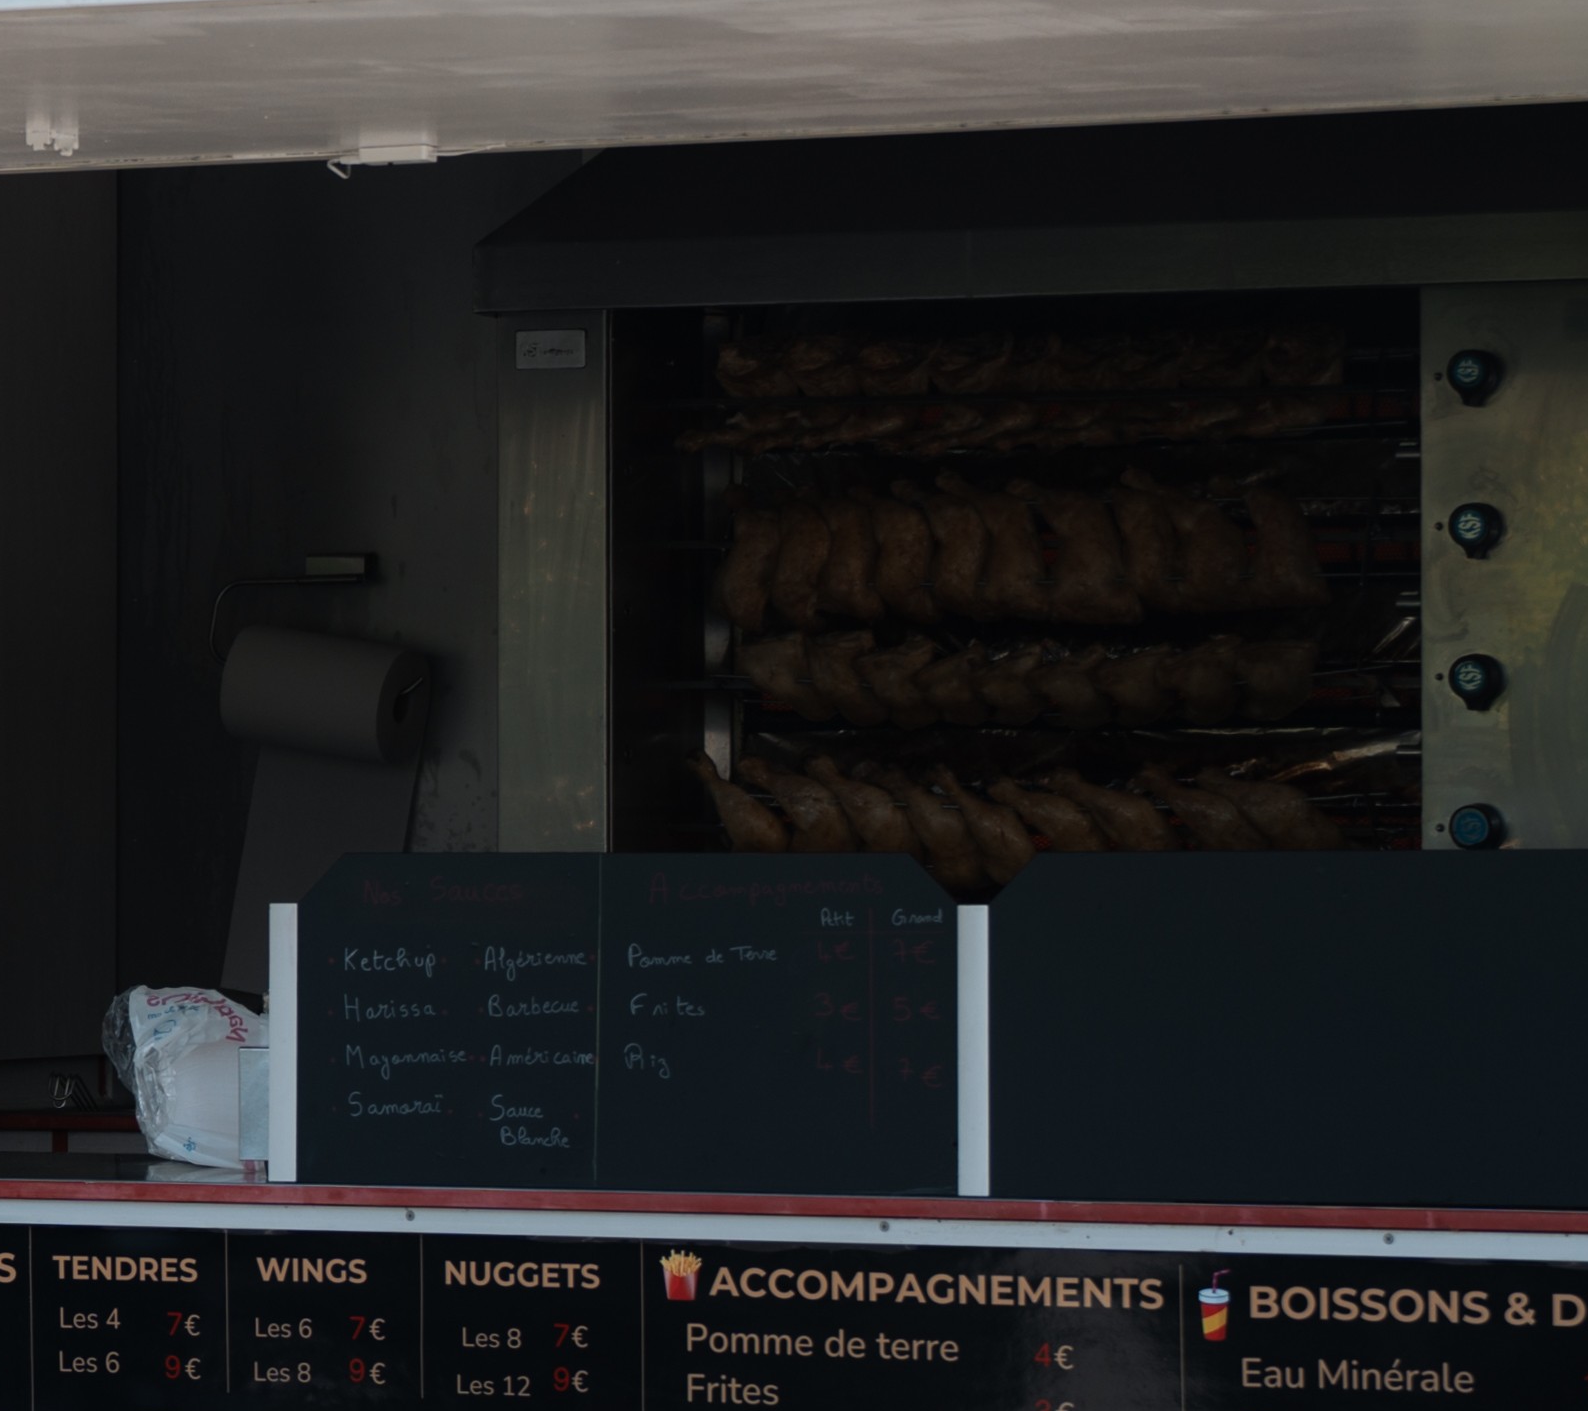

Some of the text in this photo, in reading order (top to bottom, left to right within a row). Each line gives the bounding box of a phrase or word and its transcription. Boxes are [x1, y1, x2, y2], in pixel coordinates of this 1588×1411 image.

[820, 907, 855, 927] Petit
[343, 945, 588, 982] Ketchup Algérienne
[628, 943, 692, 968] Pomme
[705, 949, 724, 963] de
[343, 993, 581, 1022] Harissa Barbecue
[345, 1044, 596, 1080] Mayonnaise Américaine
[489, 1094, 544, 1121] Sauce
[500, 1126, 570, 1148] Blanche
[52, 1255, 198, 1282] TENDRES
[256, 1257, 367, 1284] WINGS
[445, 1260, 600, 1289] NUGGETS
[709, 1267, 1164, 1310] ACCOMPAGNEMENTS
[60, 1307, 98, 1329] Les
[106, 1308, 120, 1329] 4
[1250, 1286, 1491, 1324] BOISSONS
[1504, 1292, 1536, 1326] &
[255, 1317, 291, 1338] Les
[299, 1318, 312, 1339] 6
[462, 1327, 500, 1348] Les
[507, 1328, 521, 1348] 8
[687, 1323, 813, 1356] Pomme
[825, 1329, 866, 1358] de
[876, 1333, 959, 1361] terre
[59, 1351, 97, 1373] Les
[106, 1351, 120, 1373] 6
[254, 1361, 291, 1382] Les
[297, 1362, 311, 1383] 8
[1242, 1357, 1304, 1388] Eau
[1318, 1359, 1474, 1393] Minérale
[457, 1374, 494, 1395] Les
[504, 1376, 530, 1396] 12
[687, 1373, 779, 1405] Frites
